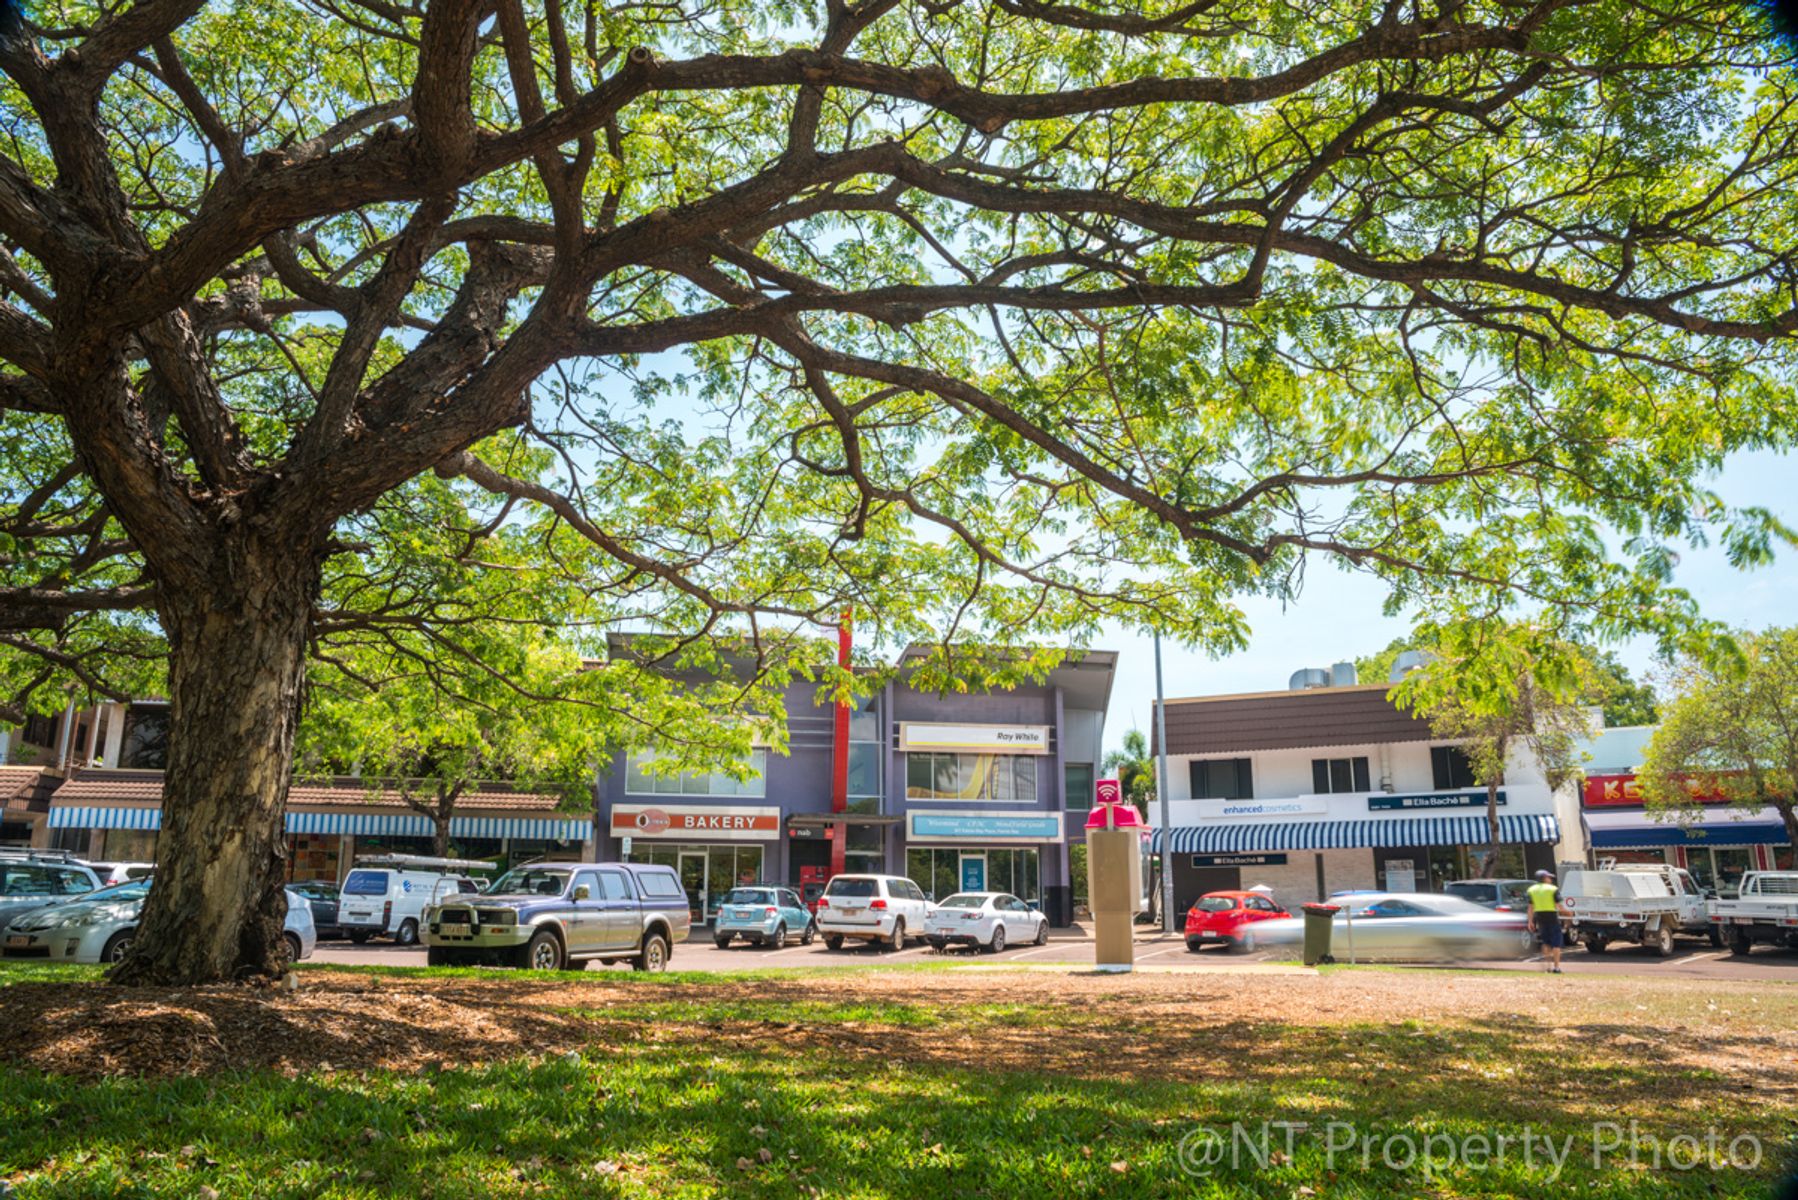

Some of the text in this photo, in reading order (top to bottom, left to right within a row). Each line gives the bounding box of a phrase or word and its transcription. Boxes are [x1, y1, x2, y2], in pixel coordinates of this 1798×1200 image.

[997, 732, 1039, 742] Ray White
[684, 815, 756, 829] BAKERY
